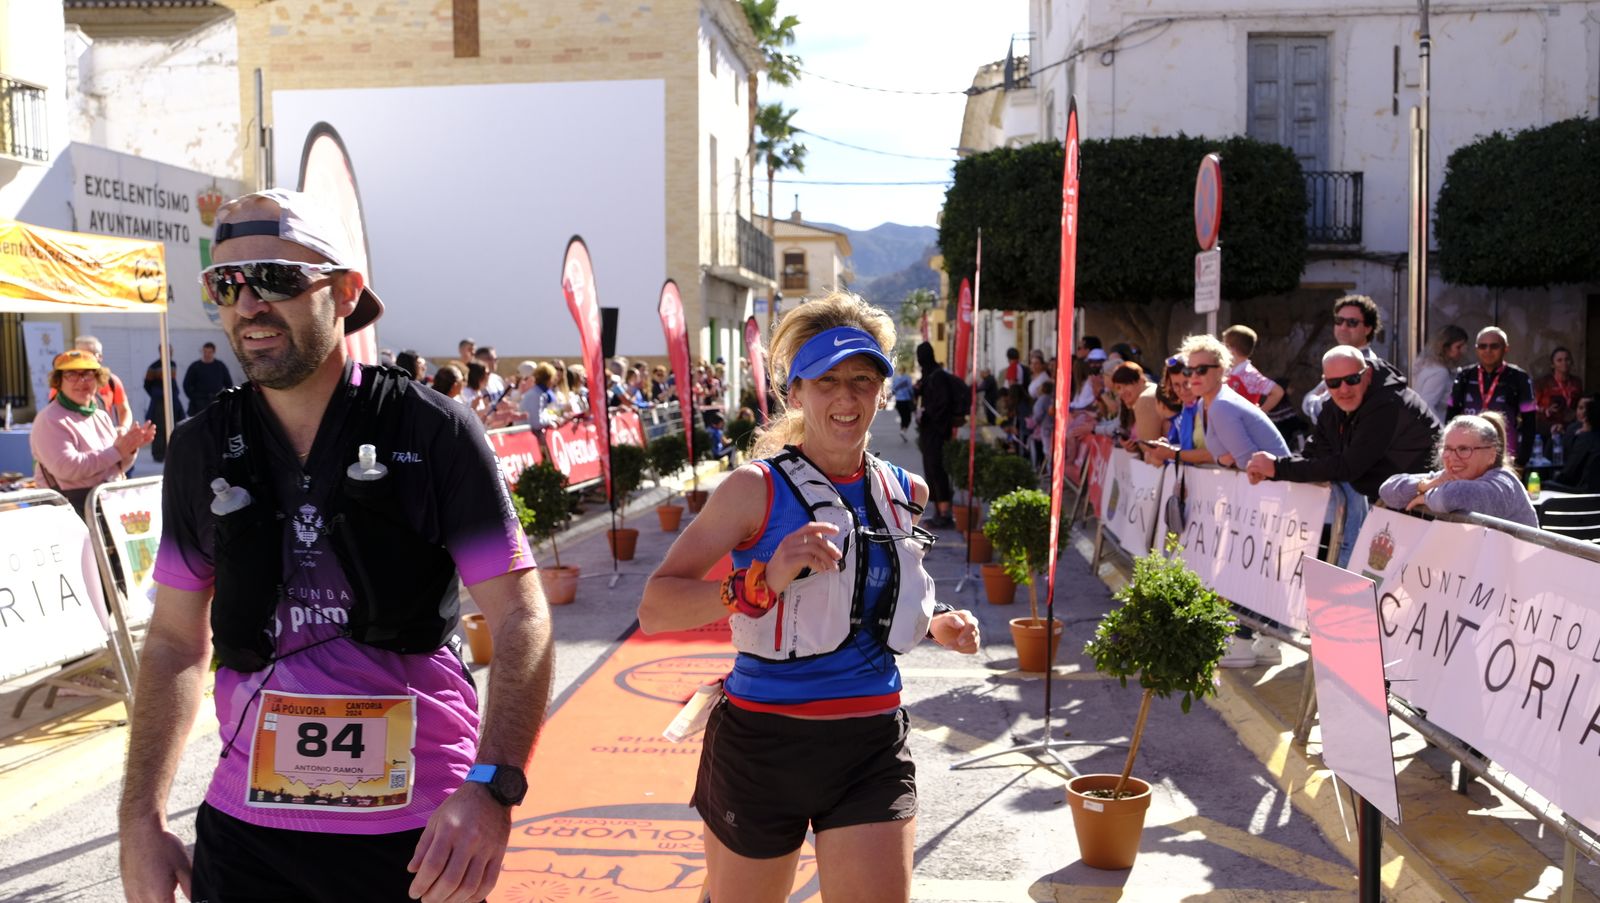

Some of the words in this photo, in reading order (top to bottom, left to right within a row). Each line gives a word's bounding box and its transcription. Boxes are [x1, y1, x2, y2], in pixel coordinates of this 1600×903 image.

[85, 175, 190, 213] EXCELENTÍSIMO
[89, 210, 191, 243] AYUNTAMIENTO
[391, 451, 423, 463] TRAIL
[1286, 519, 1309, 541] DE
[1183, 521, 1305, 590] CANTORIA
[1399, 562, 1582, 651] YUNTMIENTO
[345, 702, 384, 710] CANTORIA
[296, 722, 365, 759] 84
[294, 764, 331, 773] ANTONIO
[333, 765, 364, 774] RAMON
